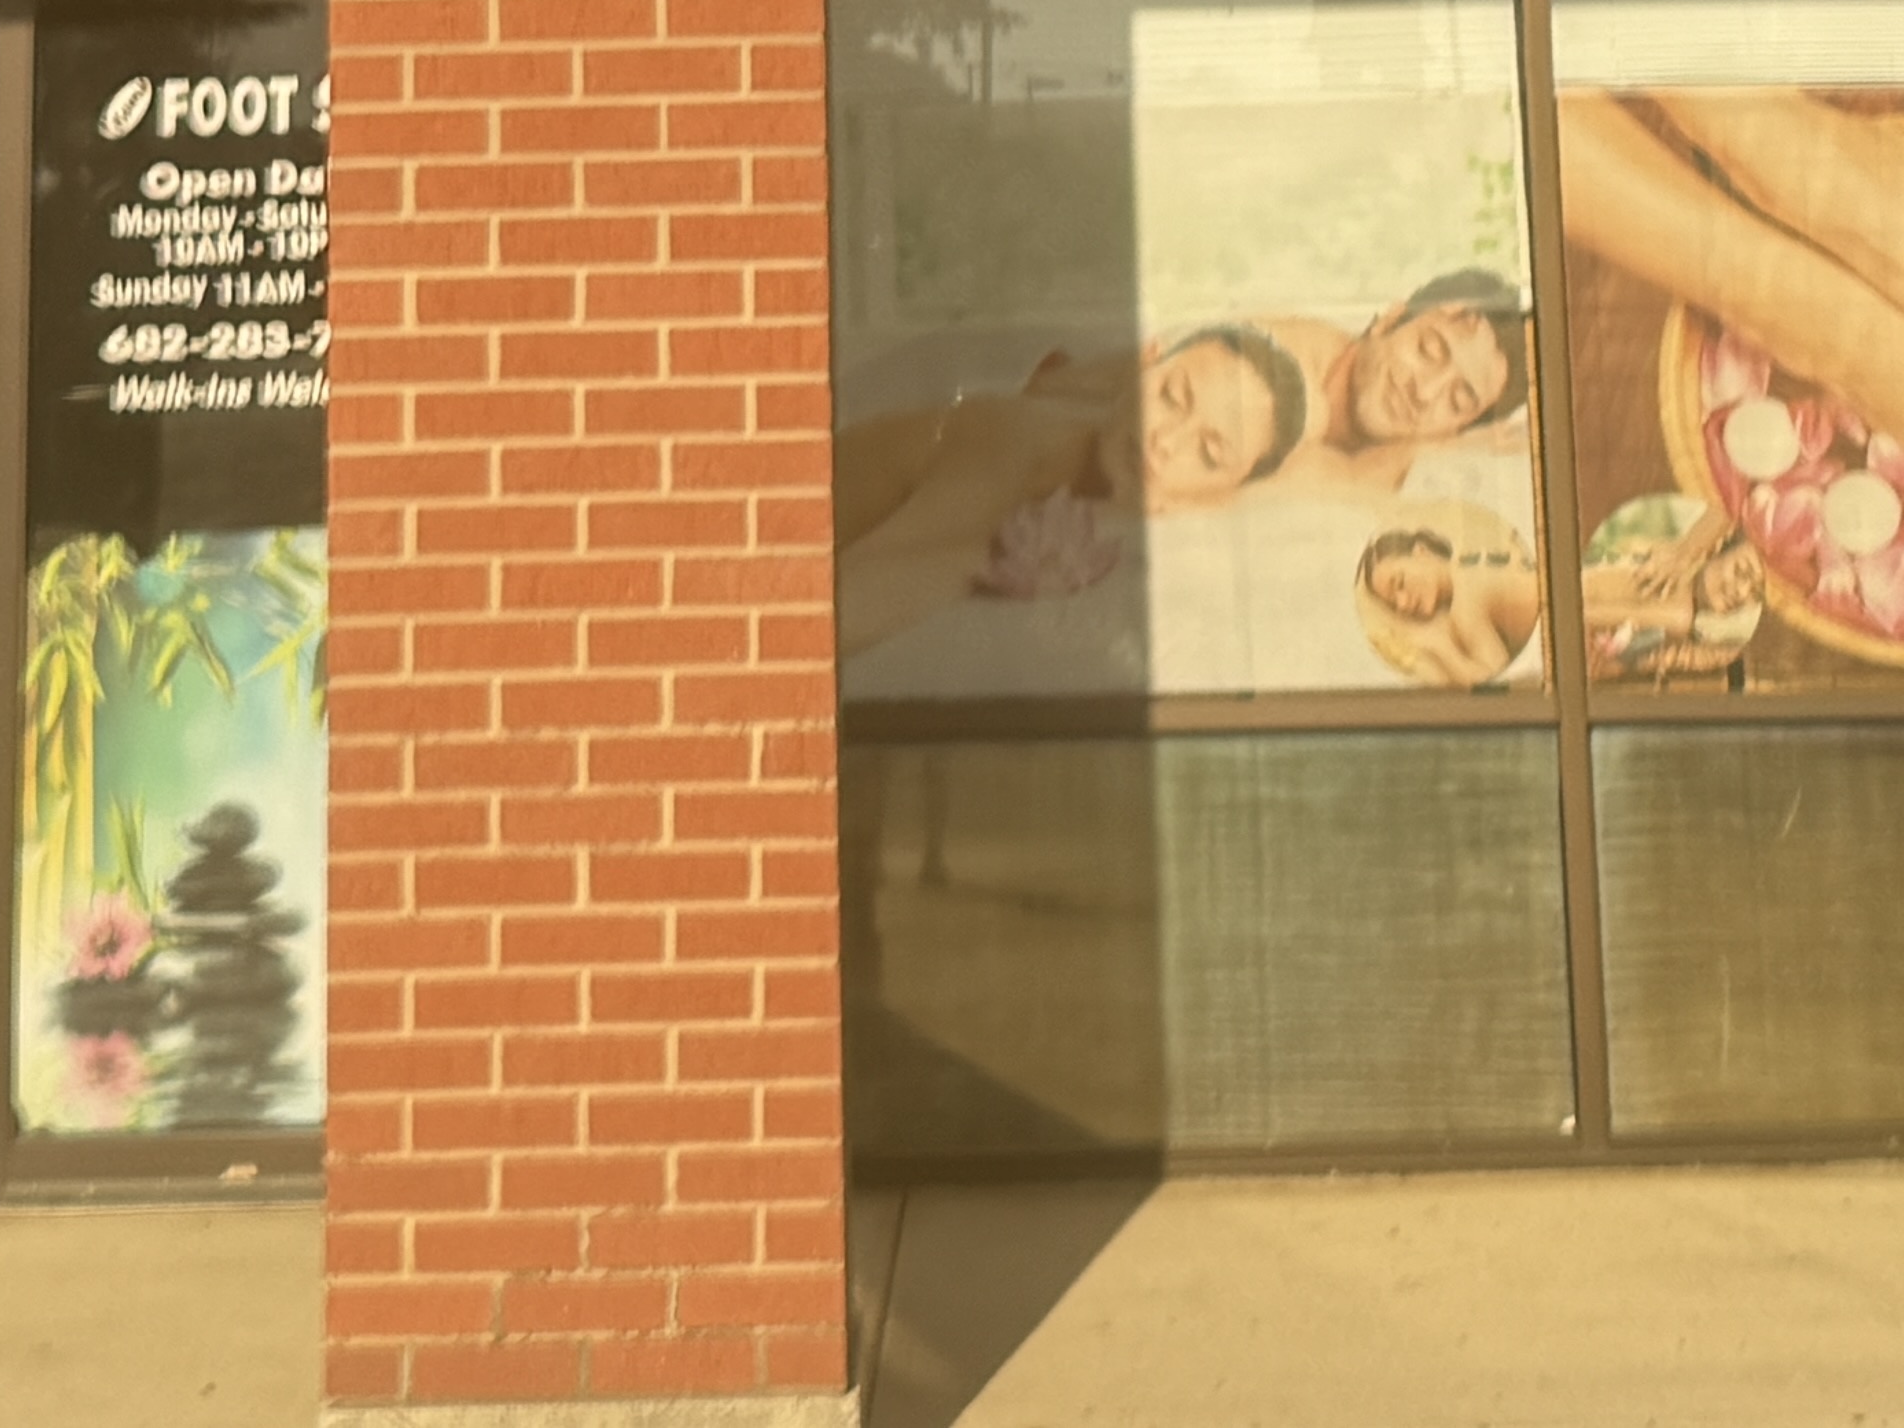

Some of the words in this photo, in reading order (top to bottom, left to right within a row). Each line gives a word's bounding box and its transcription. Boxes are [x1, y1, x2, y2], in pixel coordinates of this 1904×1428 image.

[156, 74, 300, 138] FOOT
[140, 160, 257, 208] Open
[110, 201, 238, 239] Monday
[152, 230, 245, 267] 10AM
[89, 269, 208, 310] Sunday
[213, 269, 306, 308] 11AM
[109, 370, 253, 414] Walk-Ins
